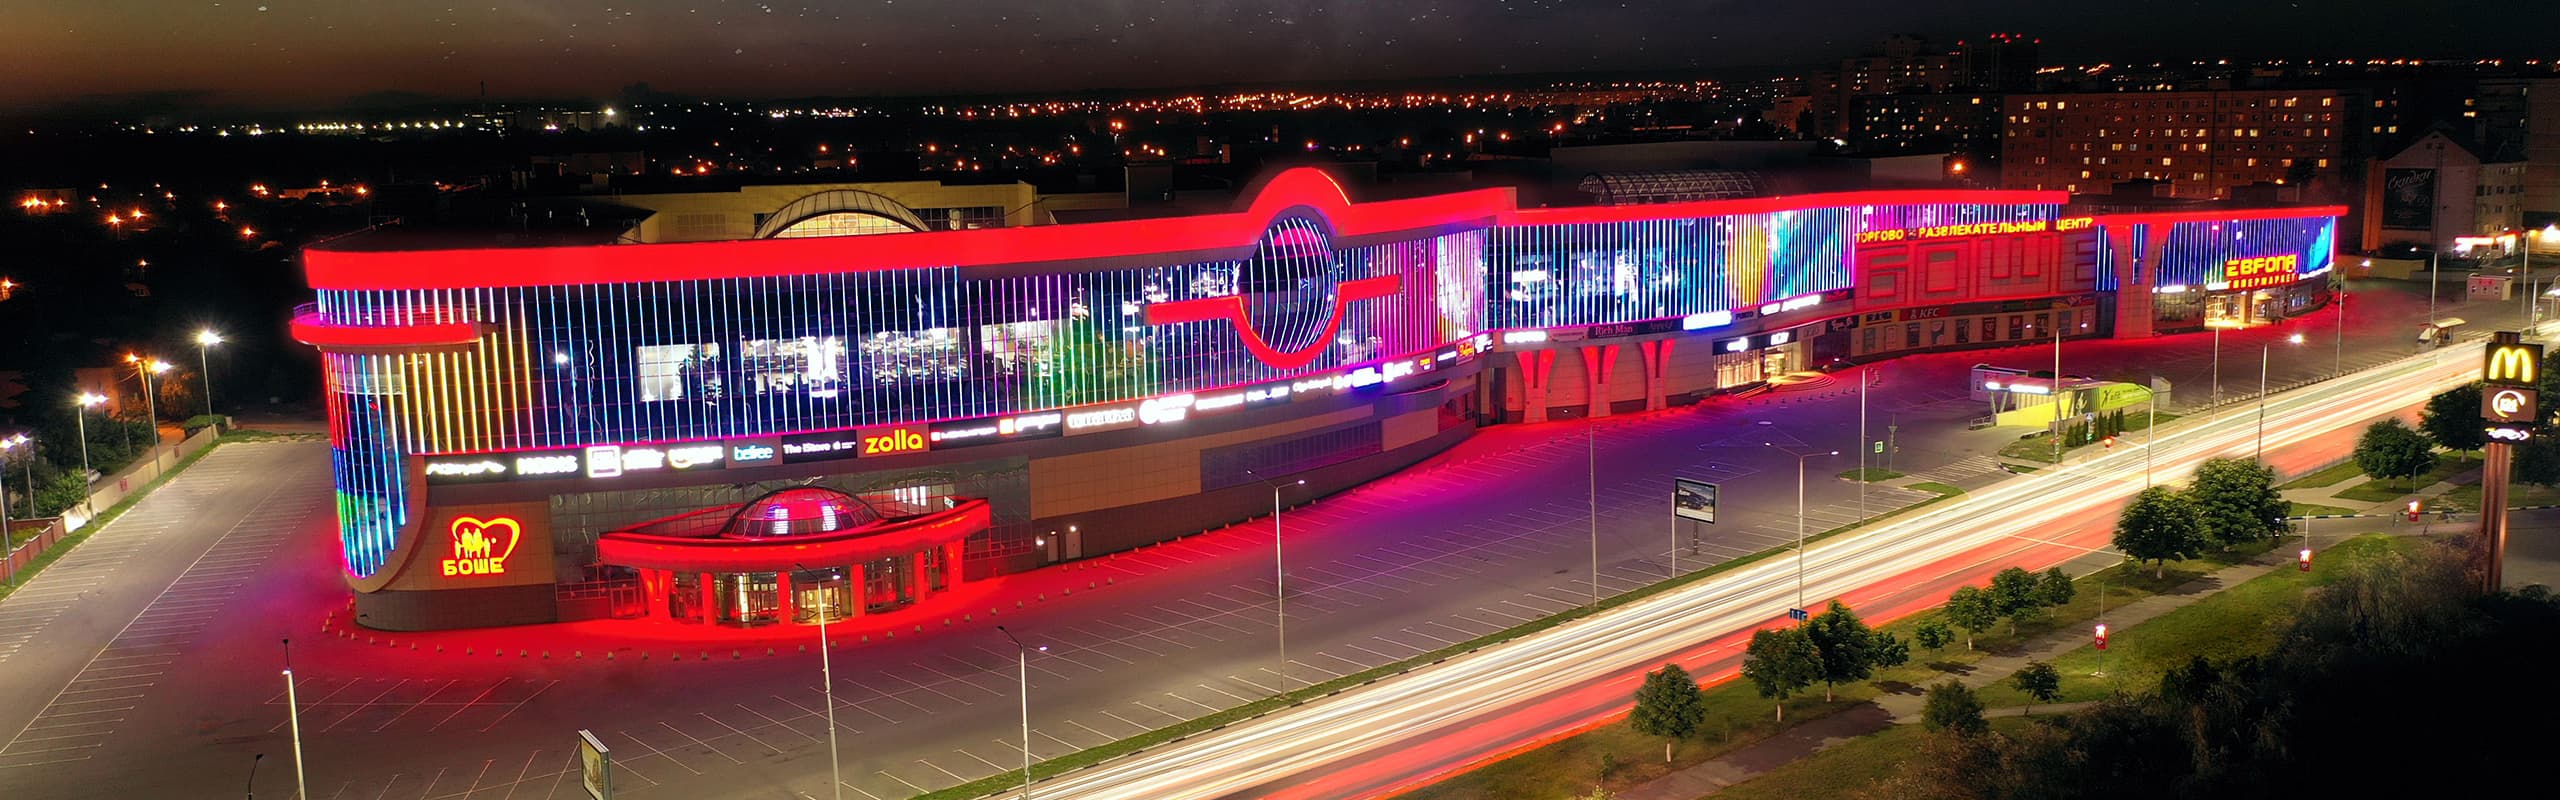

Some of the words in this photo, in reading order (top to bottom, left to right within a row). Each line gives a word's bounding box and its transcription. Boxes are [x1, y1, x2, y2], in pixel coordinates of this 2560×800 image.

[2388, 170, 2432, 190] Скидки
[1855, 229, 1905, 243] ТОРГОВО
[1918, 220, 2047, 239] РАЗВЛЕКАТЕЛЬНЫЙ
[2056, 217, 2094, 231] ЦЕНТР
[1919, 307, 1940, 317] KFC
[1595, 326, 1613, 336] Rich
[1615, 324, 1633, 334] Man
[864, 429, 923, 454] zolla
[442, 557, 505, 576] БОШЕ
